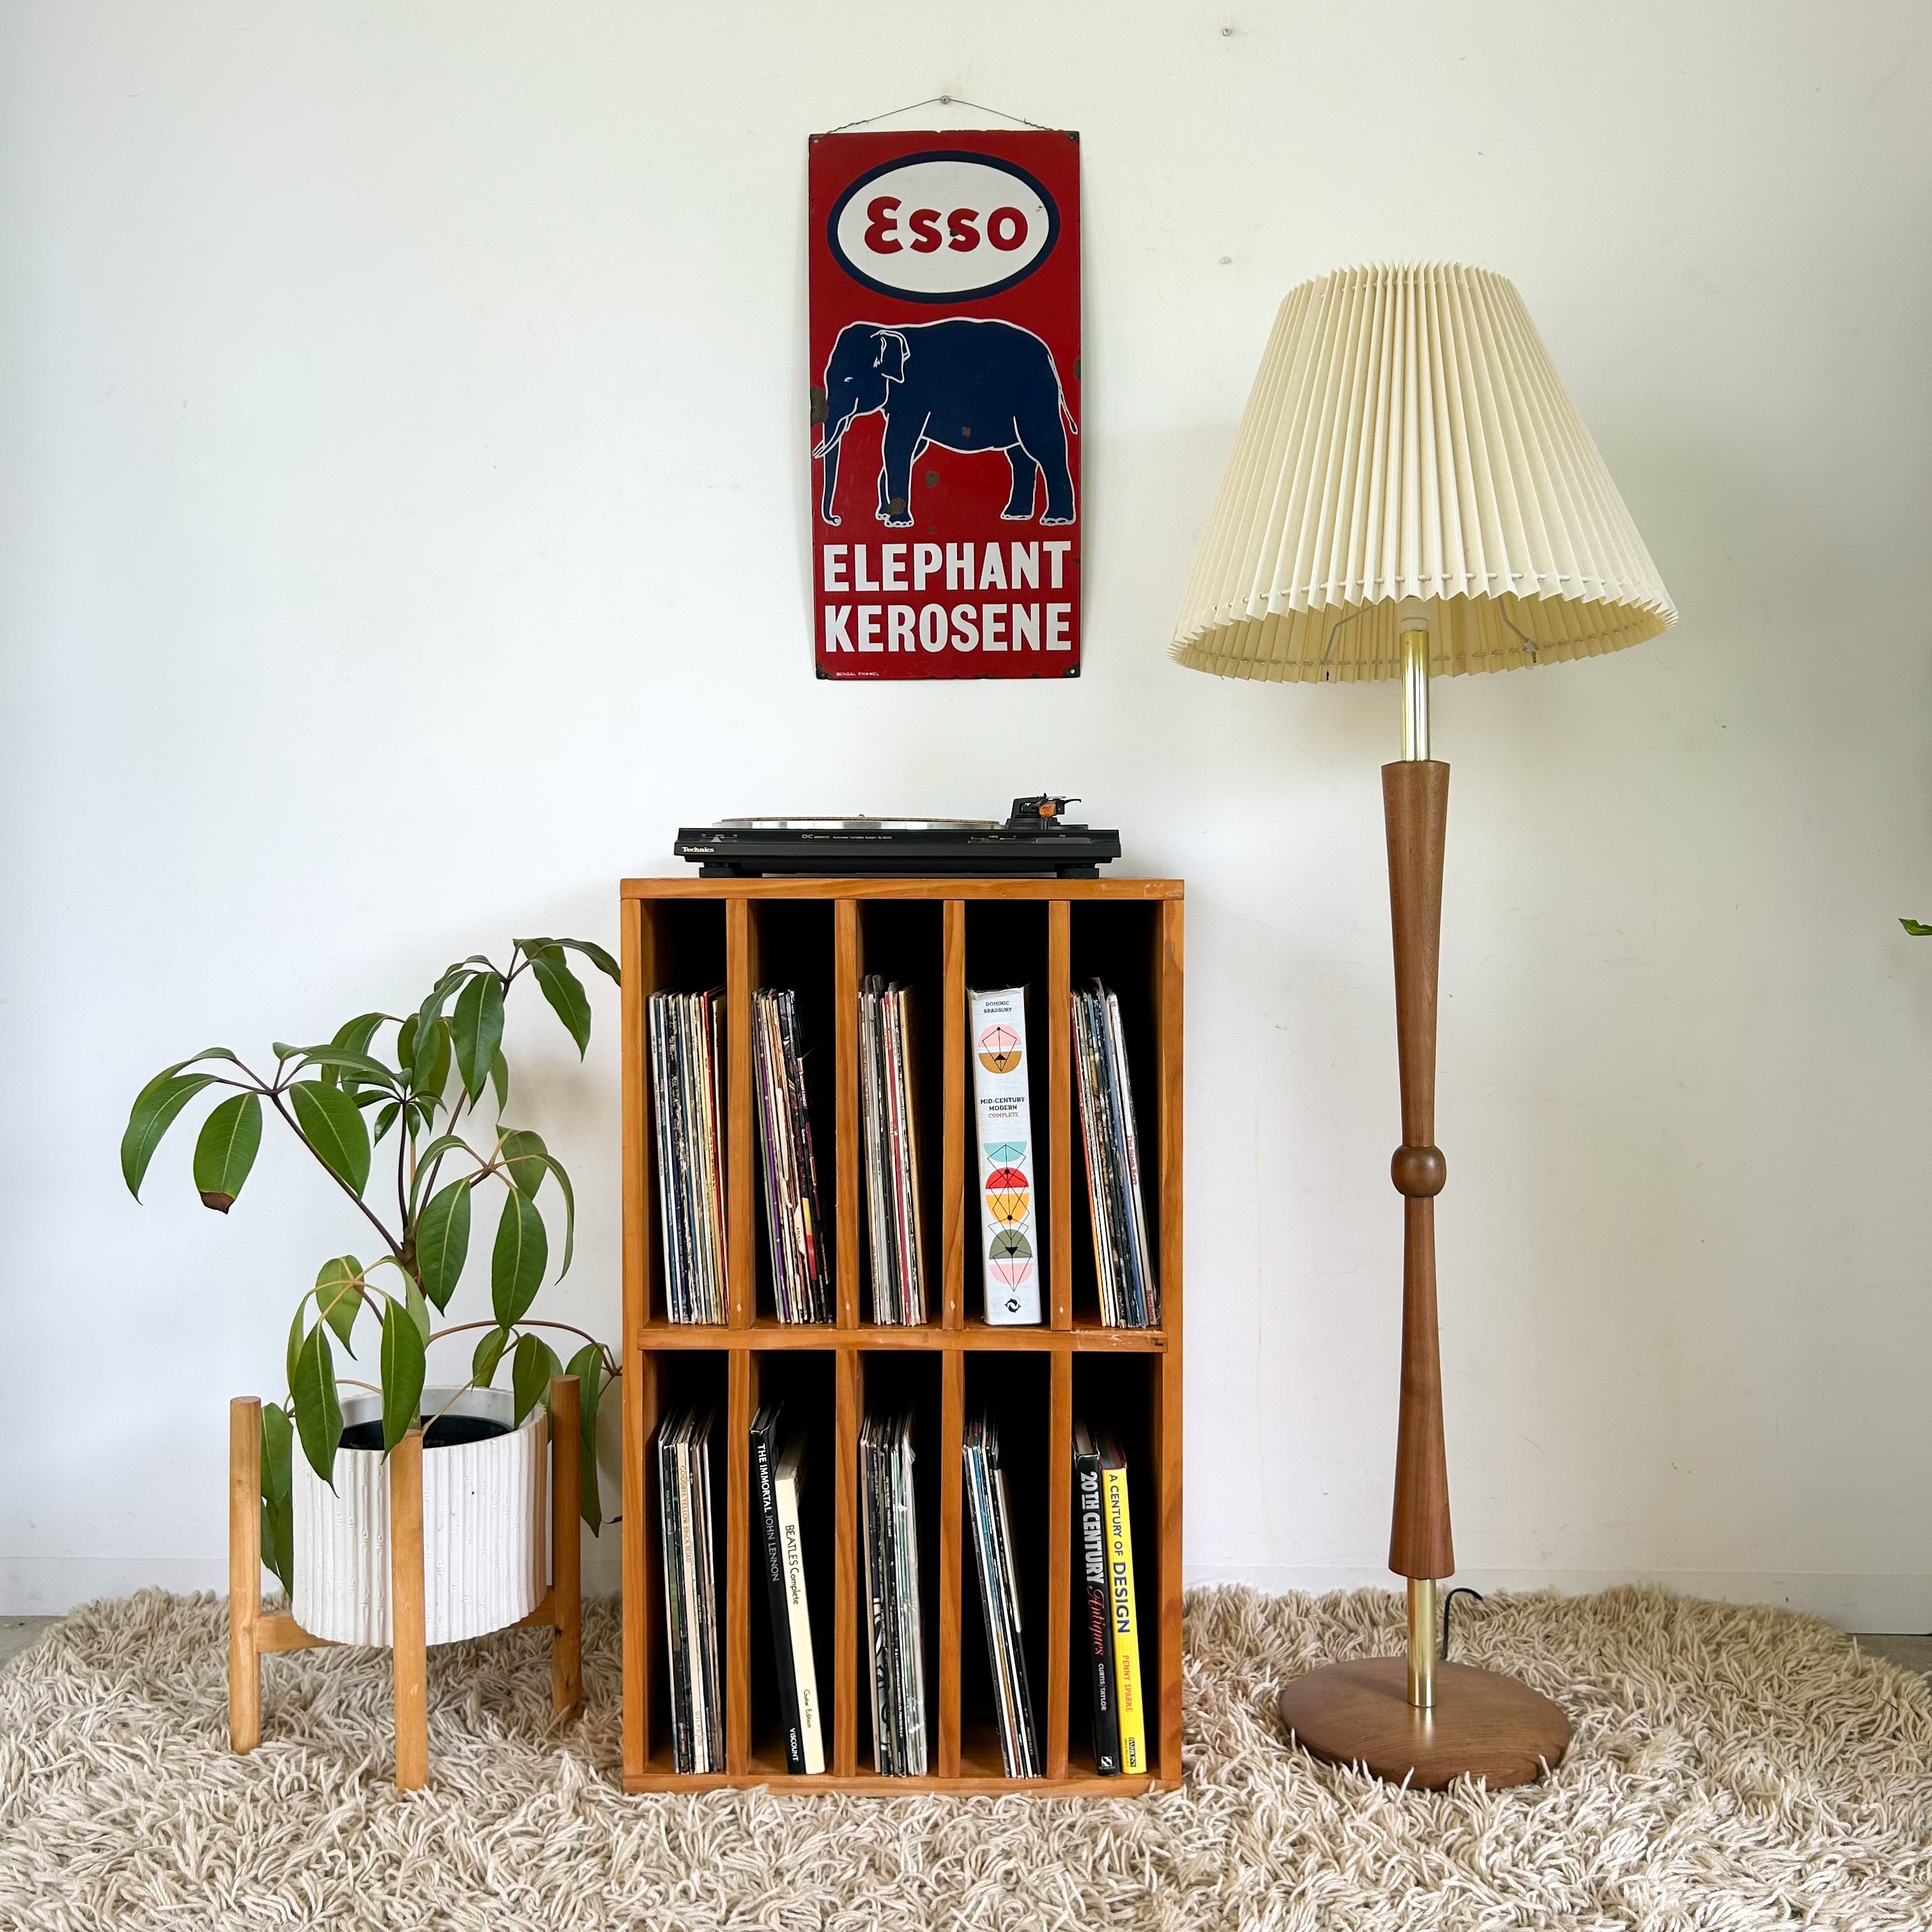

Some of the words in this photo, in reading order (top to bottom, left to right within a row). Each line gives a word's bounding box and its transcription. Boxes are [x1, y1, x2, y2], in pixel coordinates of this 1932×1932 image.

[864, 196, 1028, 254] Esso
[824, 541, 1071, 592] ELEPHANT
[825, 603, 1071, 653] KEROSENE
[757, 1443, 767, 1462] THE
[760, 1464, 772, 1513] IMMORTAL
[1080, 1471, 1100, 1510] 20TH
[1110, 1474, 1118, 1482] A
[765, 1515, 775, 1540] JOHN
[1110, 1485, 1122, 1538] CENTURY
[768, 1542, 780, 1581] LENNON
[785, 1524, 799, 1566] BEATLES
[1082, 1512, 1104, 1584] CENTURY
[1114, 1541, 1123, 1556] OF
[790, 1567, 801, 1605] Complete
[1113, 1562, 1130, 1633] DESIGN
[1087, 1586, 1105, 1656] Antiques
[1122, 1655, 1131, 1681] PENNY
[1124, 1683, 1133, 1713] SPARKE
[790, 1727, 799, 1761] VISCOUNT
